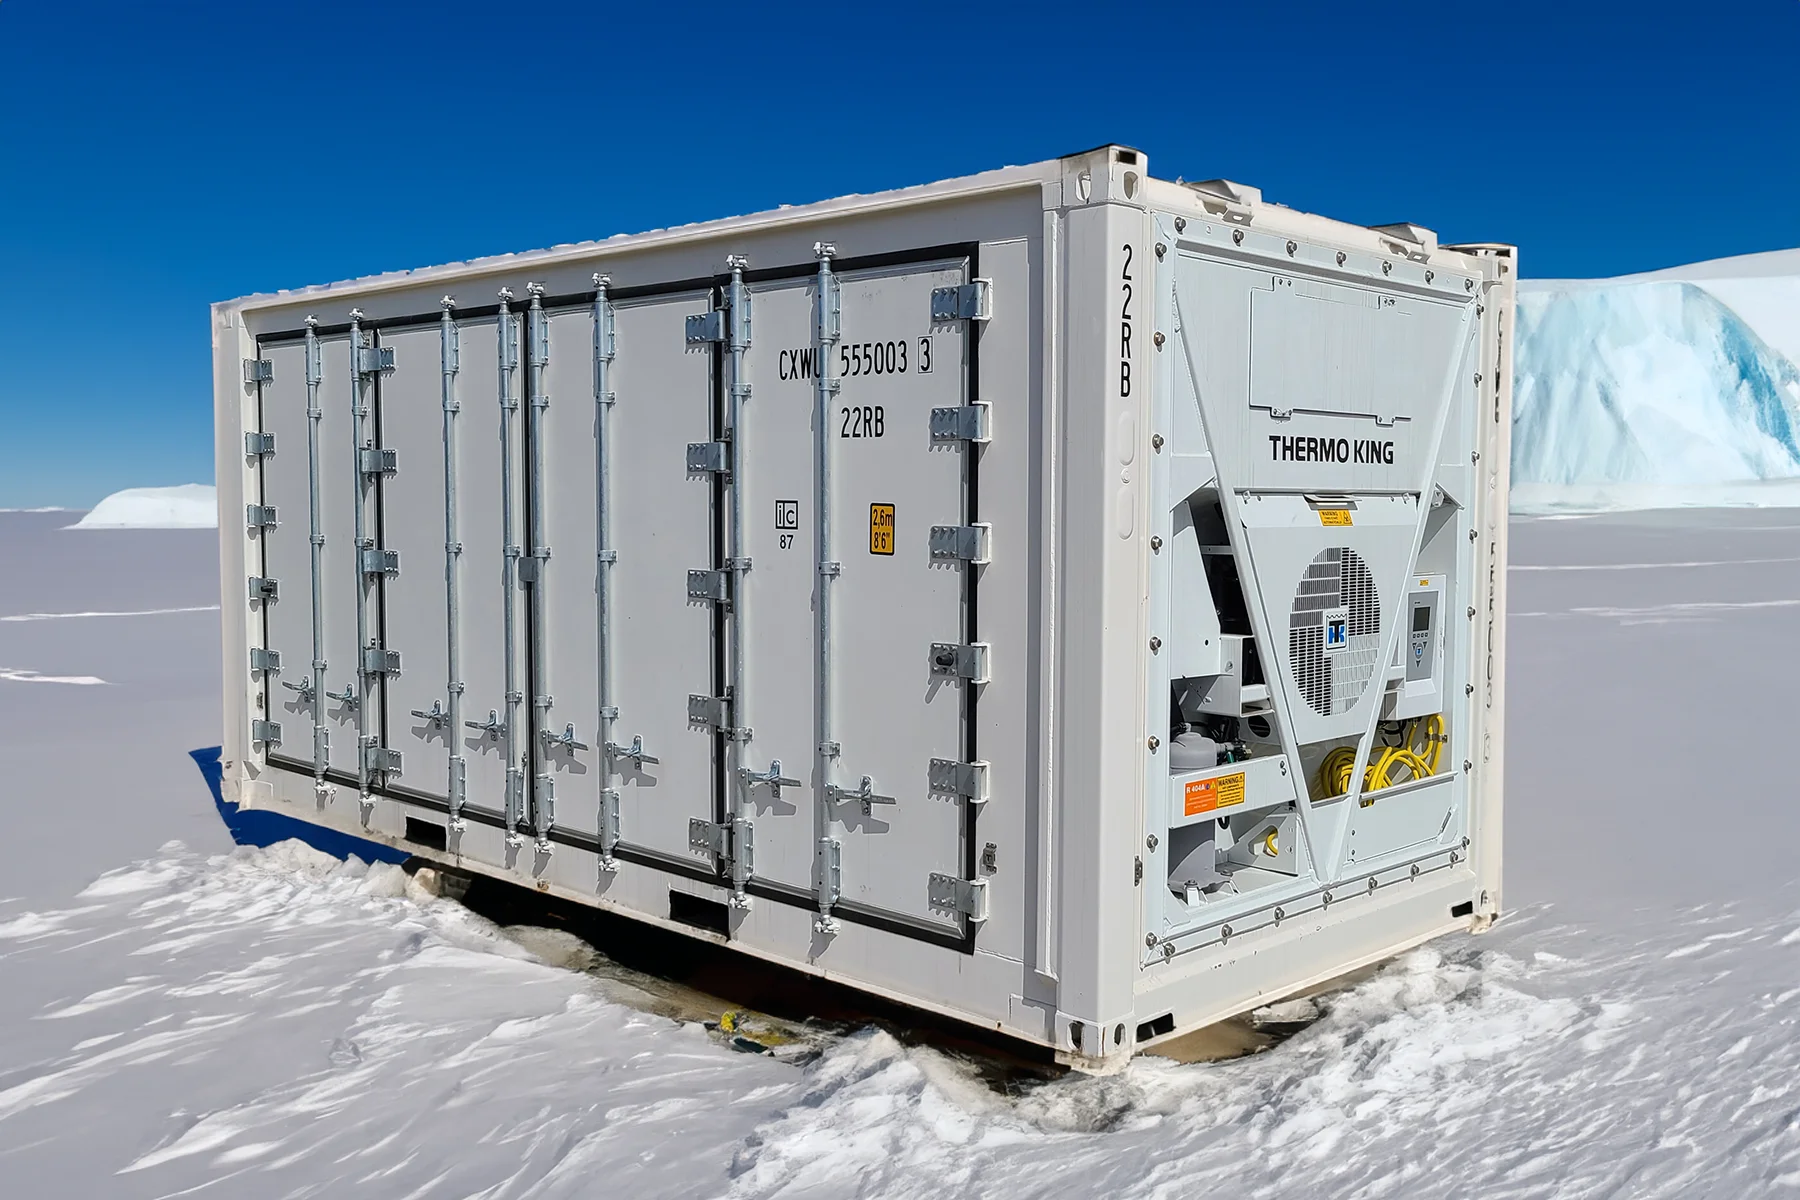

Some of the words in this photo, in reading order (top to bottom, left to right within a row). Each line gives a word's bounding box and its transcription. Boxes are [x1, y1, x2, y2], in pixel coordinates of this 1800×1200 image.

[1120, 244, 1132, 397] 22RB
[841, 340, 907, 377] 555003
[919, 337, 931, 372] 3
[841, 406, 885, 438] 22RB
[1269, 435, 1349, 463] THERMO
[1354, 439, 1394, 464] KING
[780, 534, 794, 549] 87
